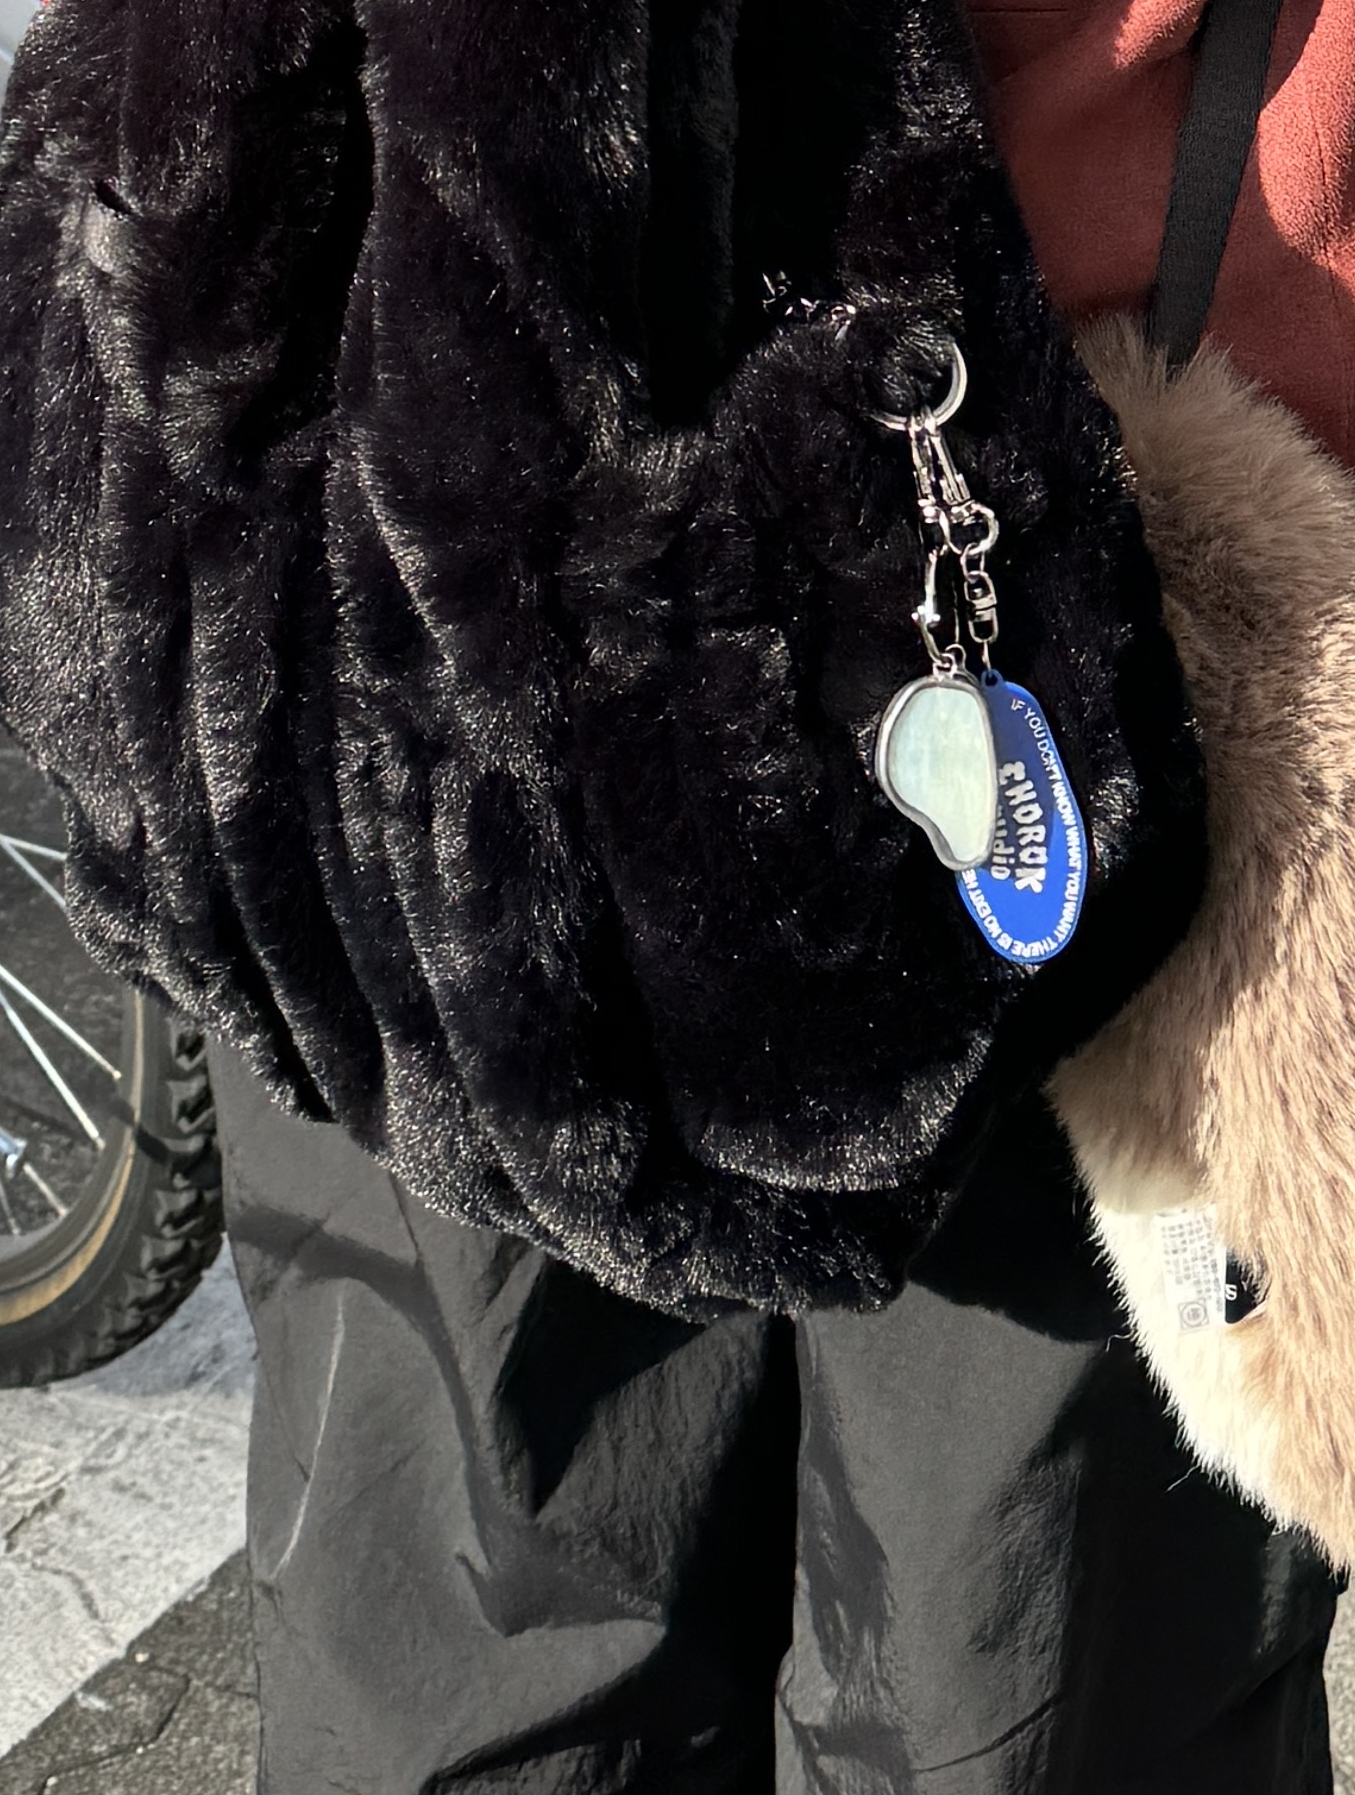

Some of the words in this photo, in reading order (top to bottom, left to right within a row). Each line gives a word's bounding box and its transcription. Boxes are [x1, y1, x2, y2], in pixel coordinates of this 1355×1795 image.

[1011, 698, 1026, 711] IF
[1024, 707, 1046, 739] YOU
[1051, 781, 1077, 826] KNOW
[1065, 825, 1082, 870] WHAT
[1064, 870, 1081, 902] YOU
[984, 915, 1002, 938] NO
[1053, 901, 1077, 943] WANT
[1011, 936, 1058, 958] THERE
